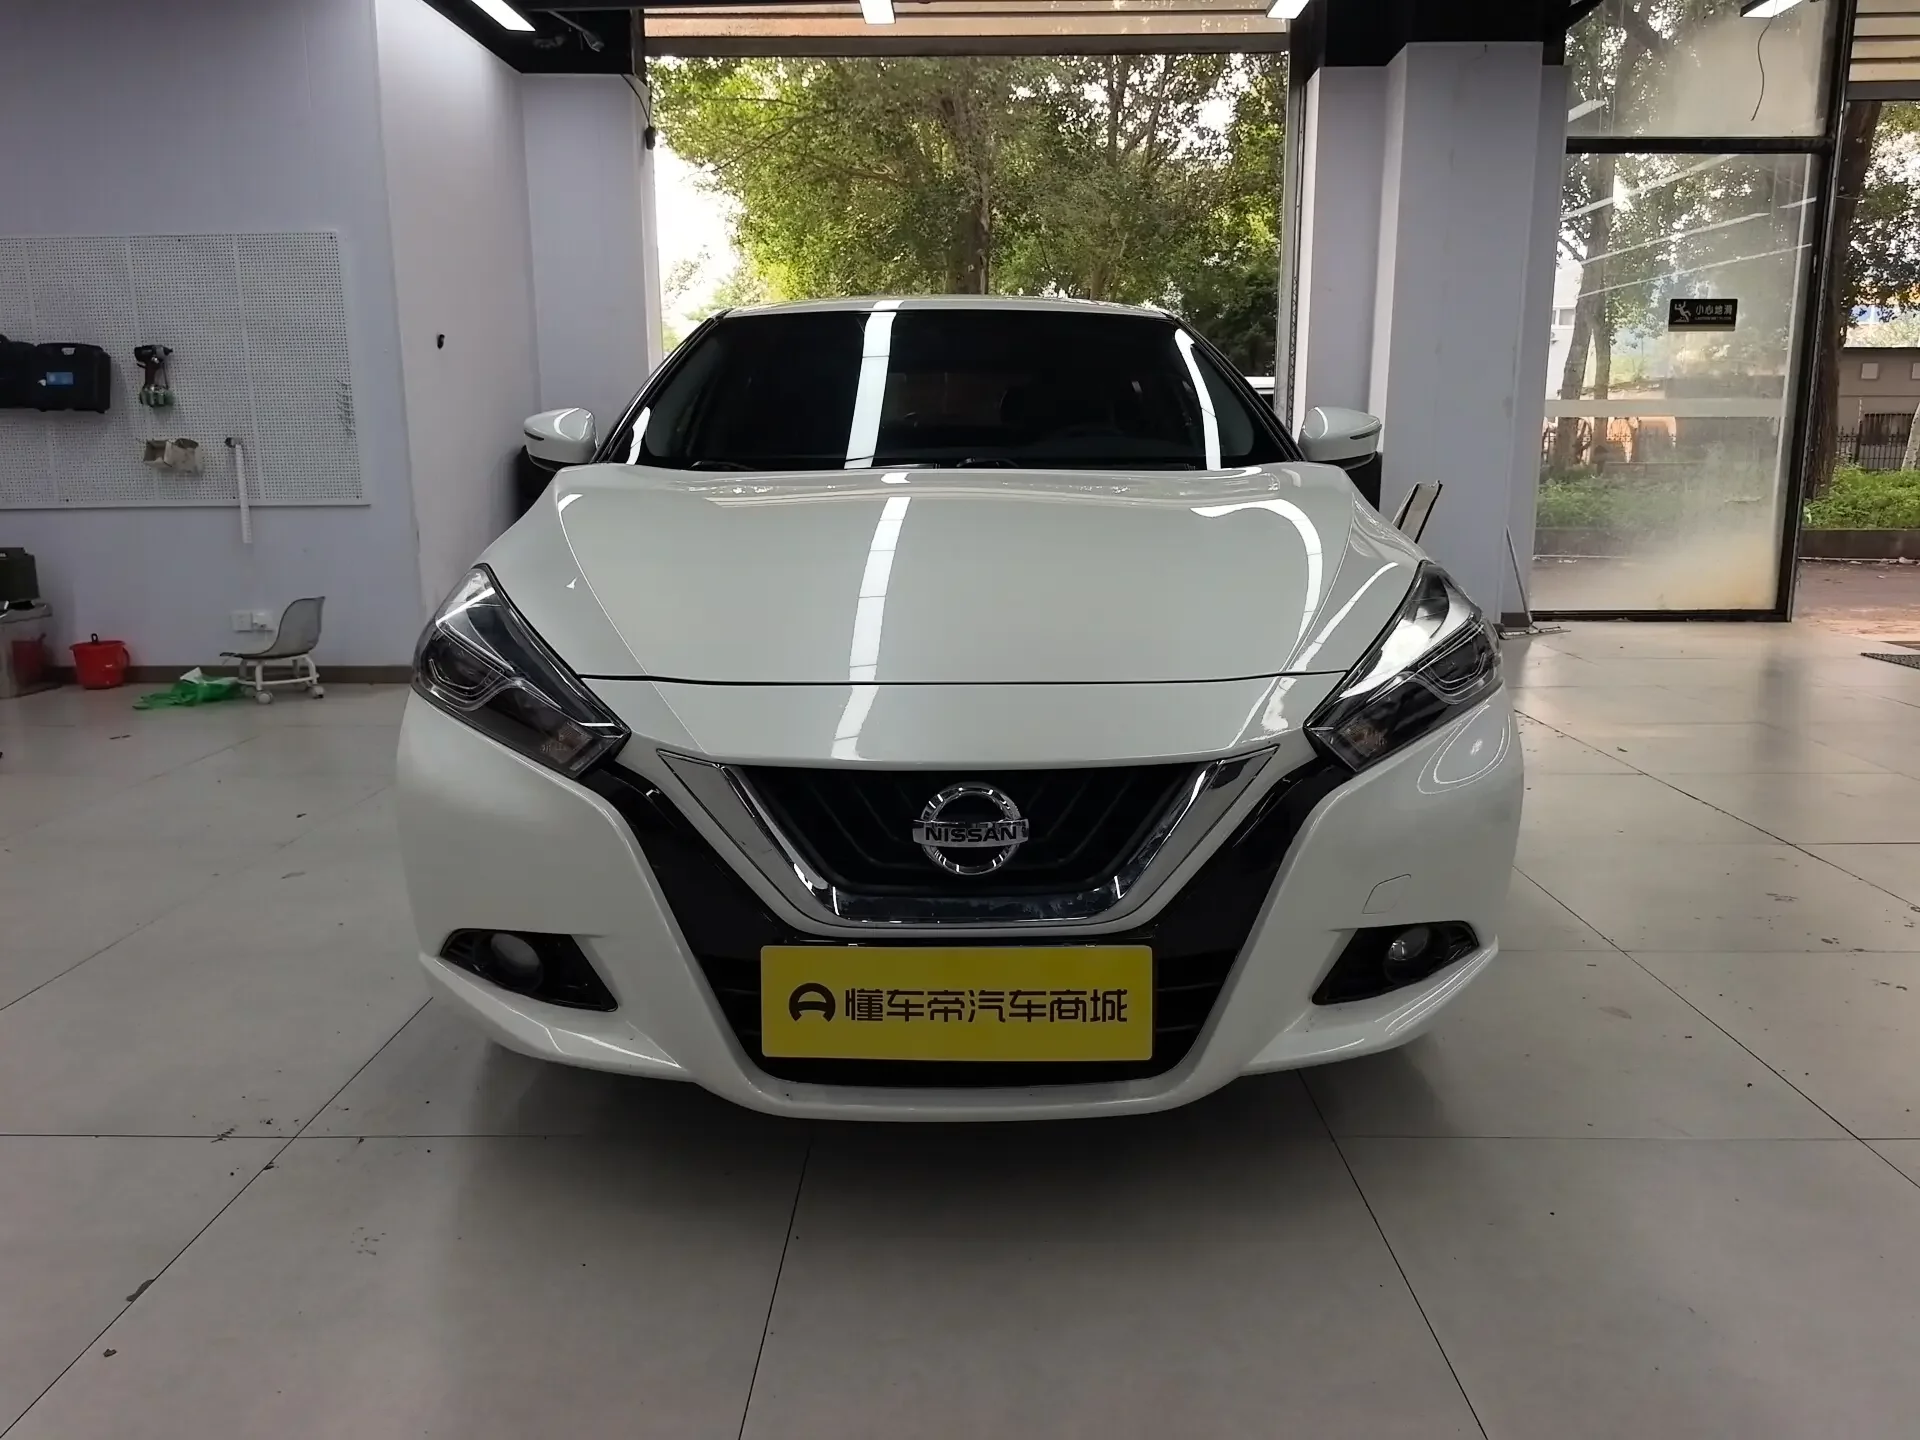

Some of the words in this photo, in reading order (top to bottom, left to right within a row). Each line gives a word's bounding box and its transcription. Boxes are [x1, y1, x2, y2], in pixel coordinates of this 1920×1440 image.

[925, 826, 1017, 843] NISSAN
[845, 988, 1128, 1023] 懂车帝汽车商城
